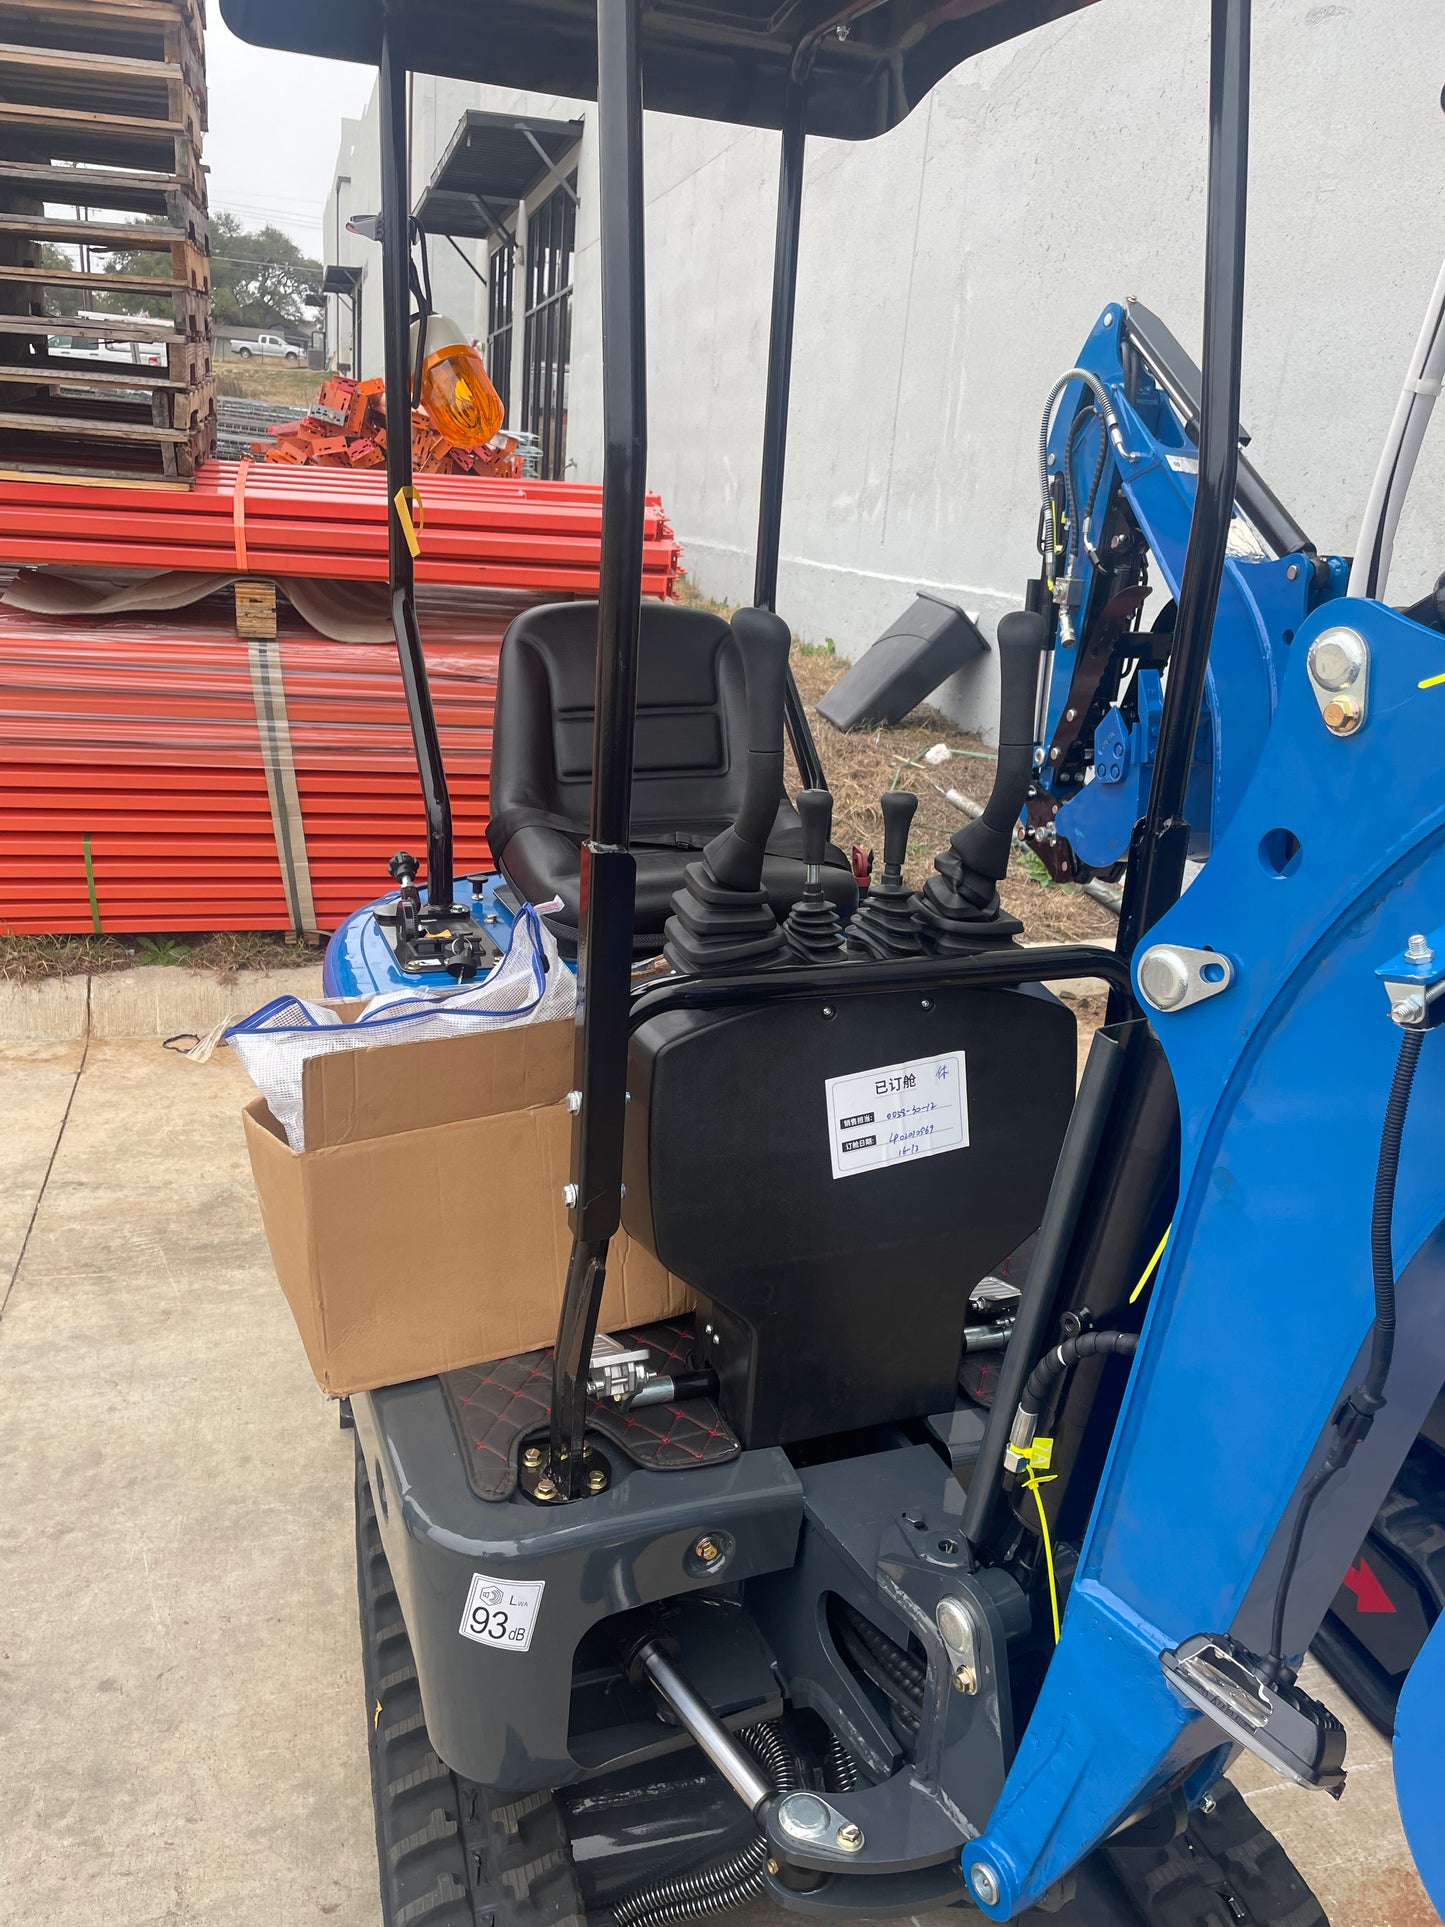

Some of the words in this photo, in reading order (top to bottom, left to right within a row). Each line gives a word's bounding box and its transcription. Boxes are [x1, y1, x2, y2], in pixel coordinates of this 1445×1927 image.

[875, 1073, 916, 1094] 已订舱
[470, 1606, 508, 1639] 93
[508, 1627, 526, 1641] dB
